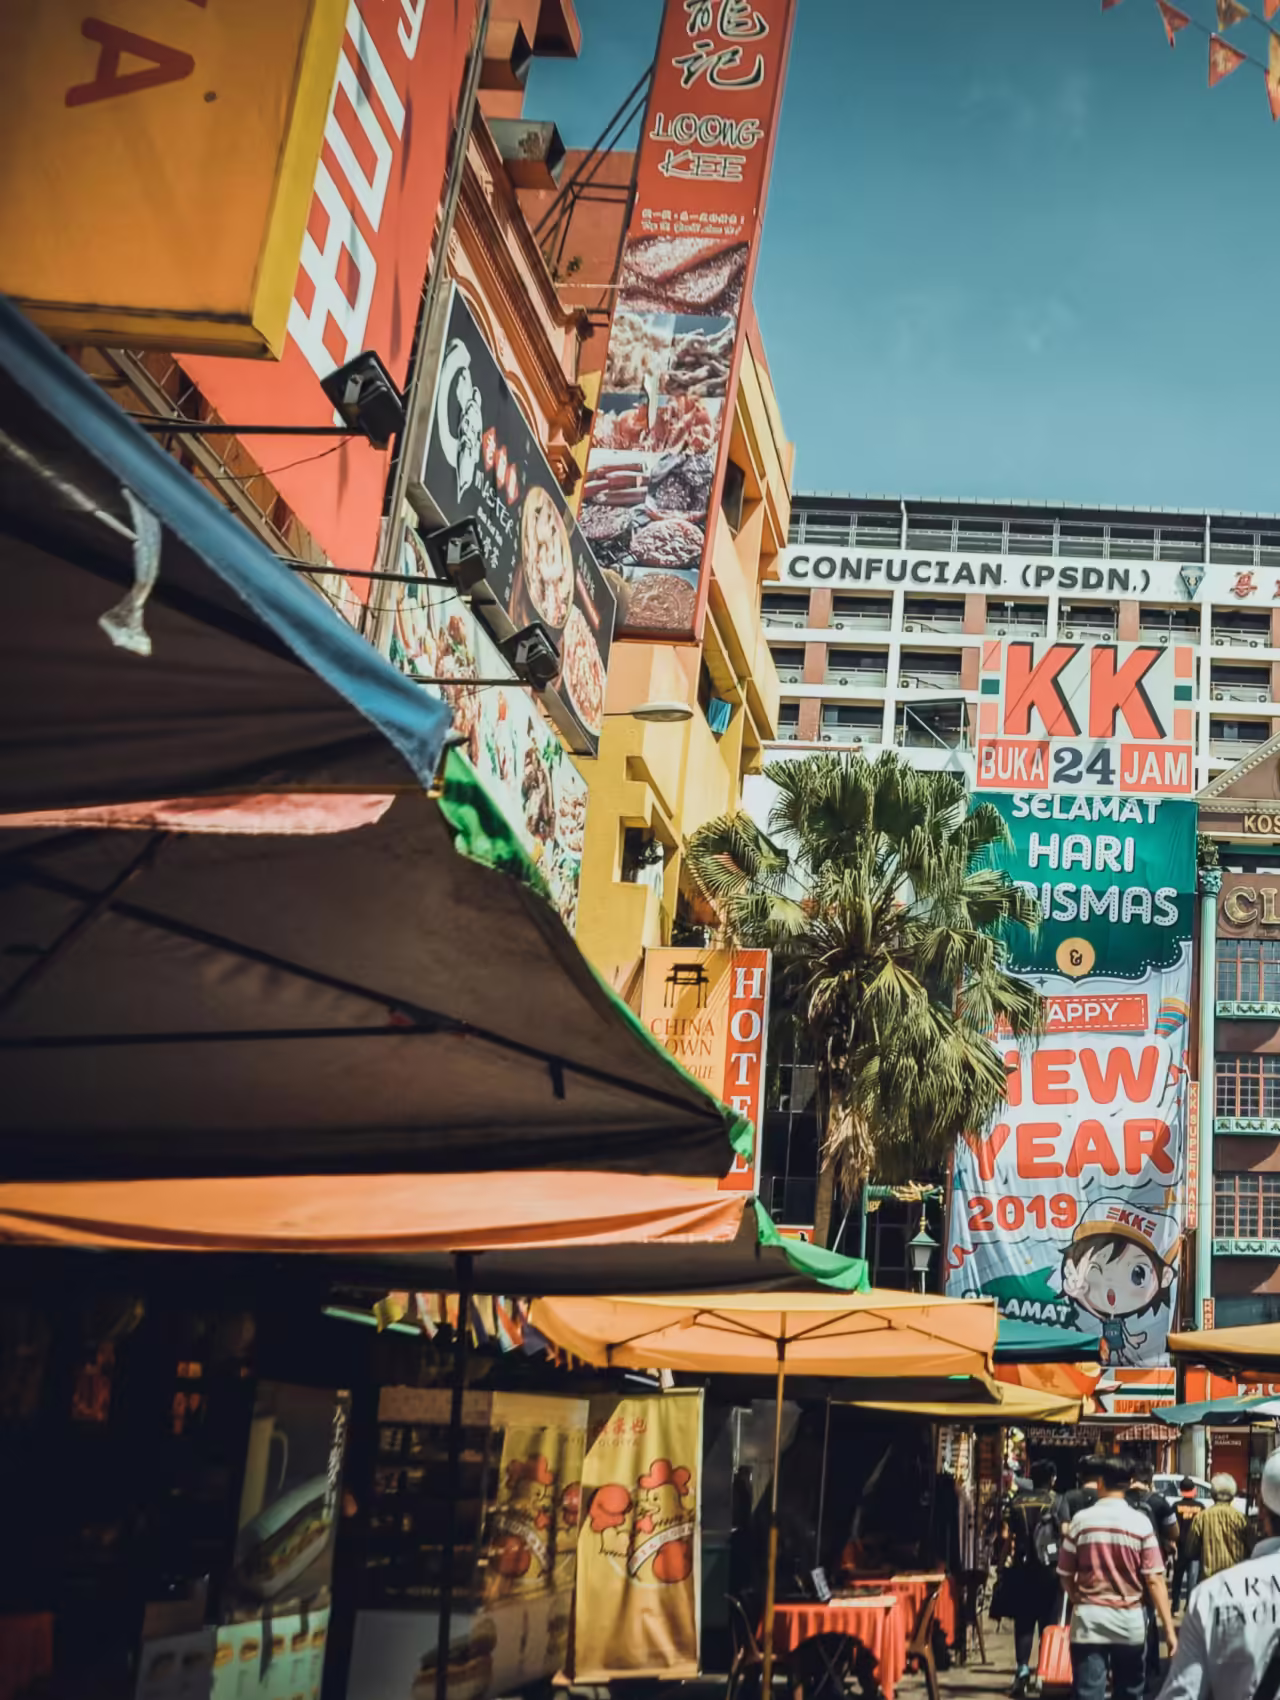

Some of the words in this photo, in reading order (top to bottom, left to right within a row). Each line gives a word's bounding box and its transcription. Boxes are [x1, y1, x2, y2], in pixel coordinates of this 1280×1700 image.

[650, 113, 764, 149] LOONG
[658, 149, 746, 182] KEE
[1003, 640, 1168, 740] KK
[980, 746, 1045, 782] BUKA
[1052, 747, 1115, 785] 24
[1124, 751, 1188, 786] JAM
[1011, 791, 1162, 824] SELAMAT
[1028, 831, 1135, 873] HARI
[1013, 881, 1179, 927] ISMAS
[650, 1017, 715, 1037] CHINA
[1048, 1001, 1119, 1023] APPY
[659, 1038, 713, 1056] OWN
[964, 1118, 1175, 1181] YEAR
[967, 1193, 1077, 1231] 2019
[1118, 1210, 1147, 1232] KK
